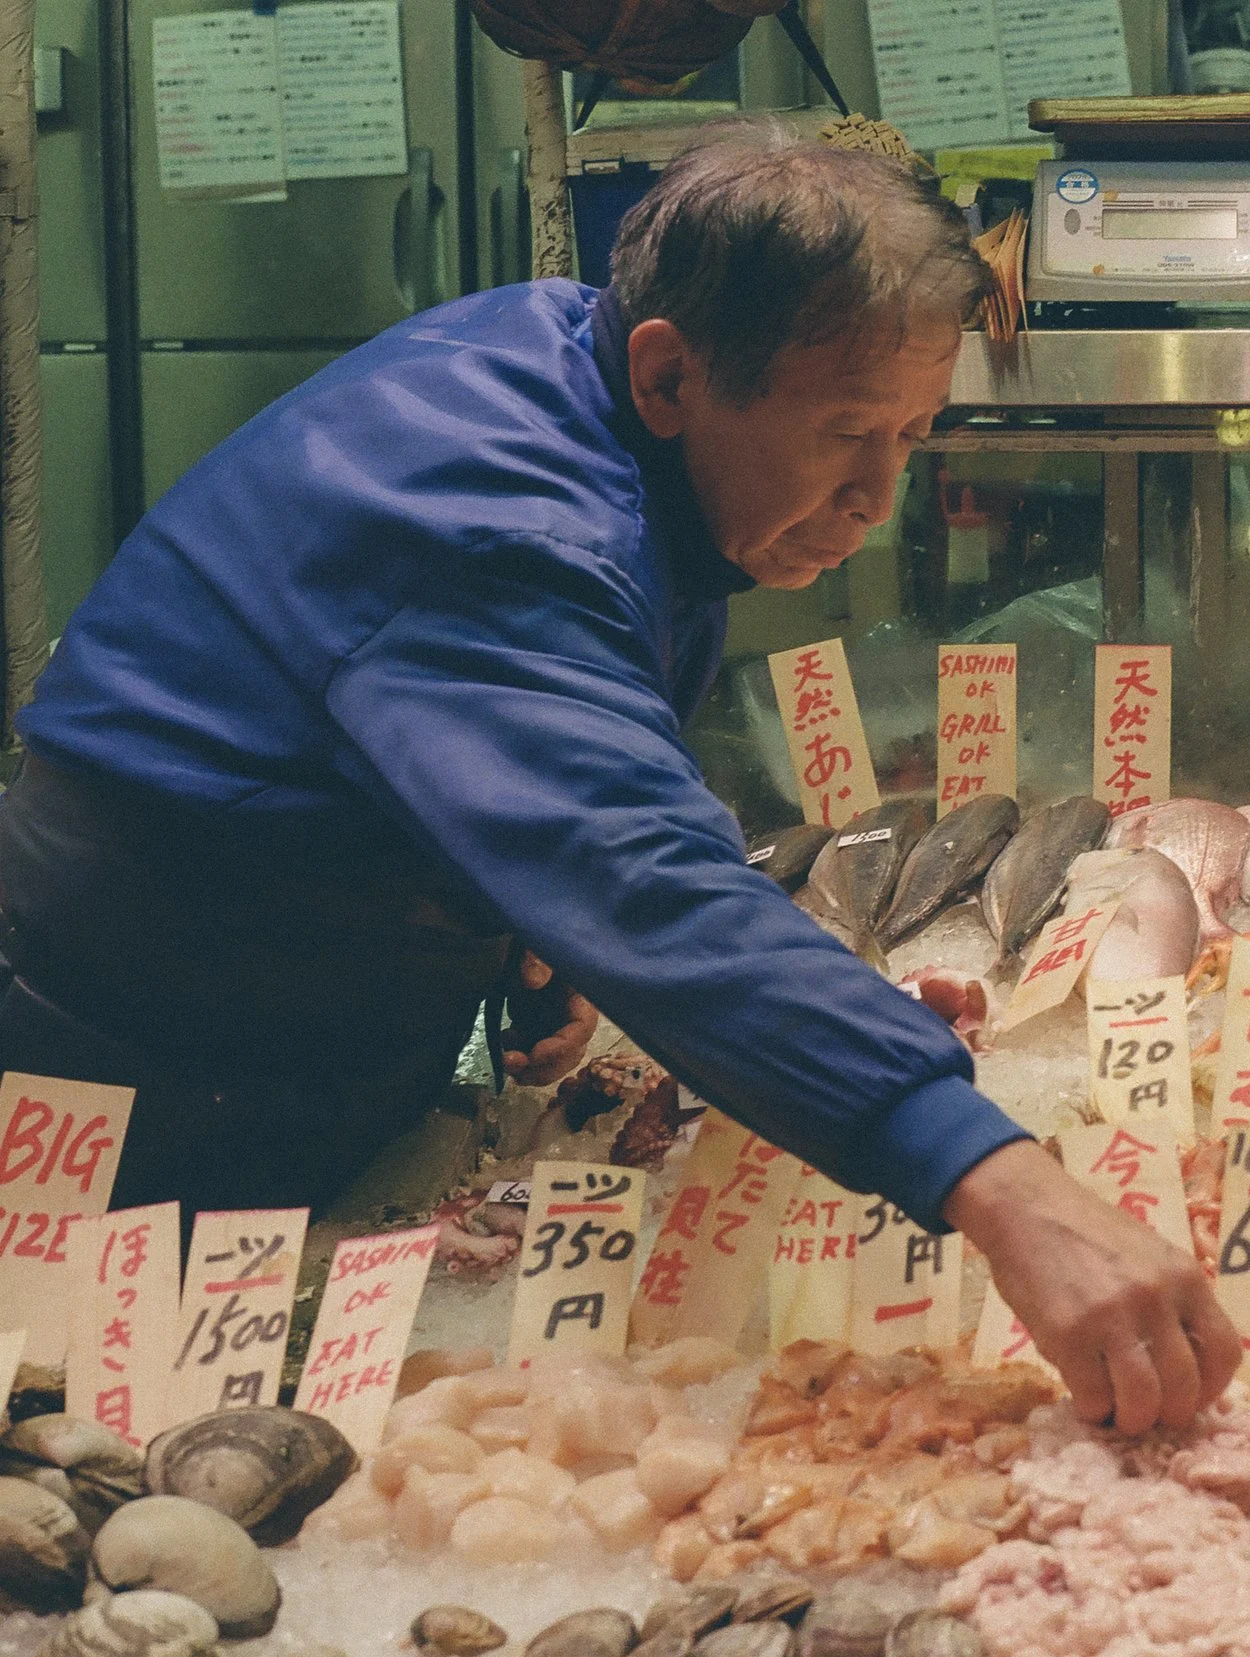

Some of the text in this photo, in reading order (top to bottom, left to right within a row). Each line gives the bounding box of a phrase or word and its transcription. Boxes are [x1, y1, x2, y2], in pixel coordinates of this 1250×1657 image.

[965, 680, 996, 698] OK
[959, 741, 991, 764] OK
[941, 776, 986, 801] EAT
[1099, 1039, 1174, 1079] 120
[1129, 1079, 1169, 1112] 円
[0, 1096, 115, 1194] BIG
[0, 1206, 82, 1264] IZE
[522, 1222, 636, 1278] 350
[904, 1232, 943, 1284] 円
[344, 1282, 391, 1314] OK
[544, 1293, 605, 1340] 円
[173, 1294, 288, 1371] 1500
[309, 1327, 385, 1376] EAT
[307, 1359, 394, 1415] HERE
